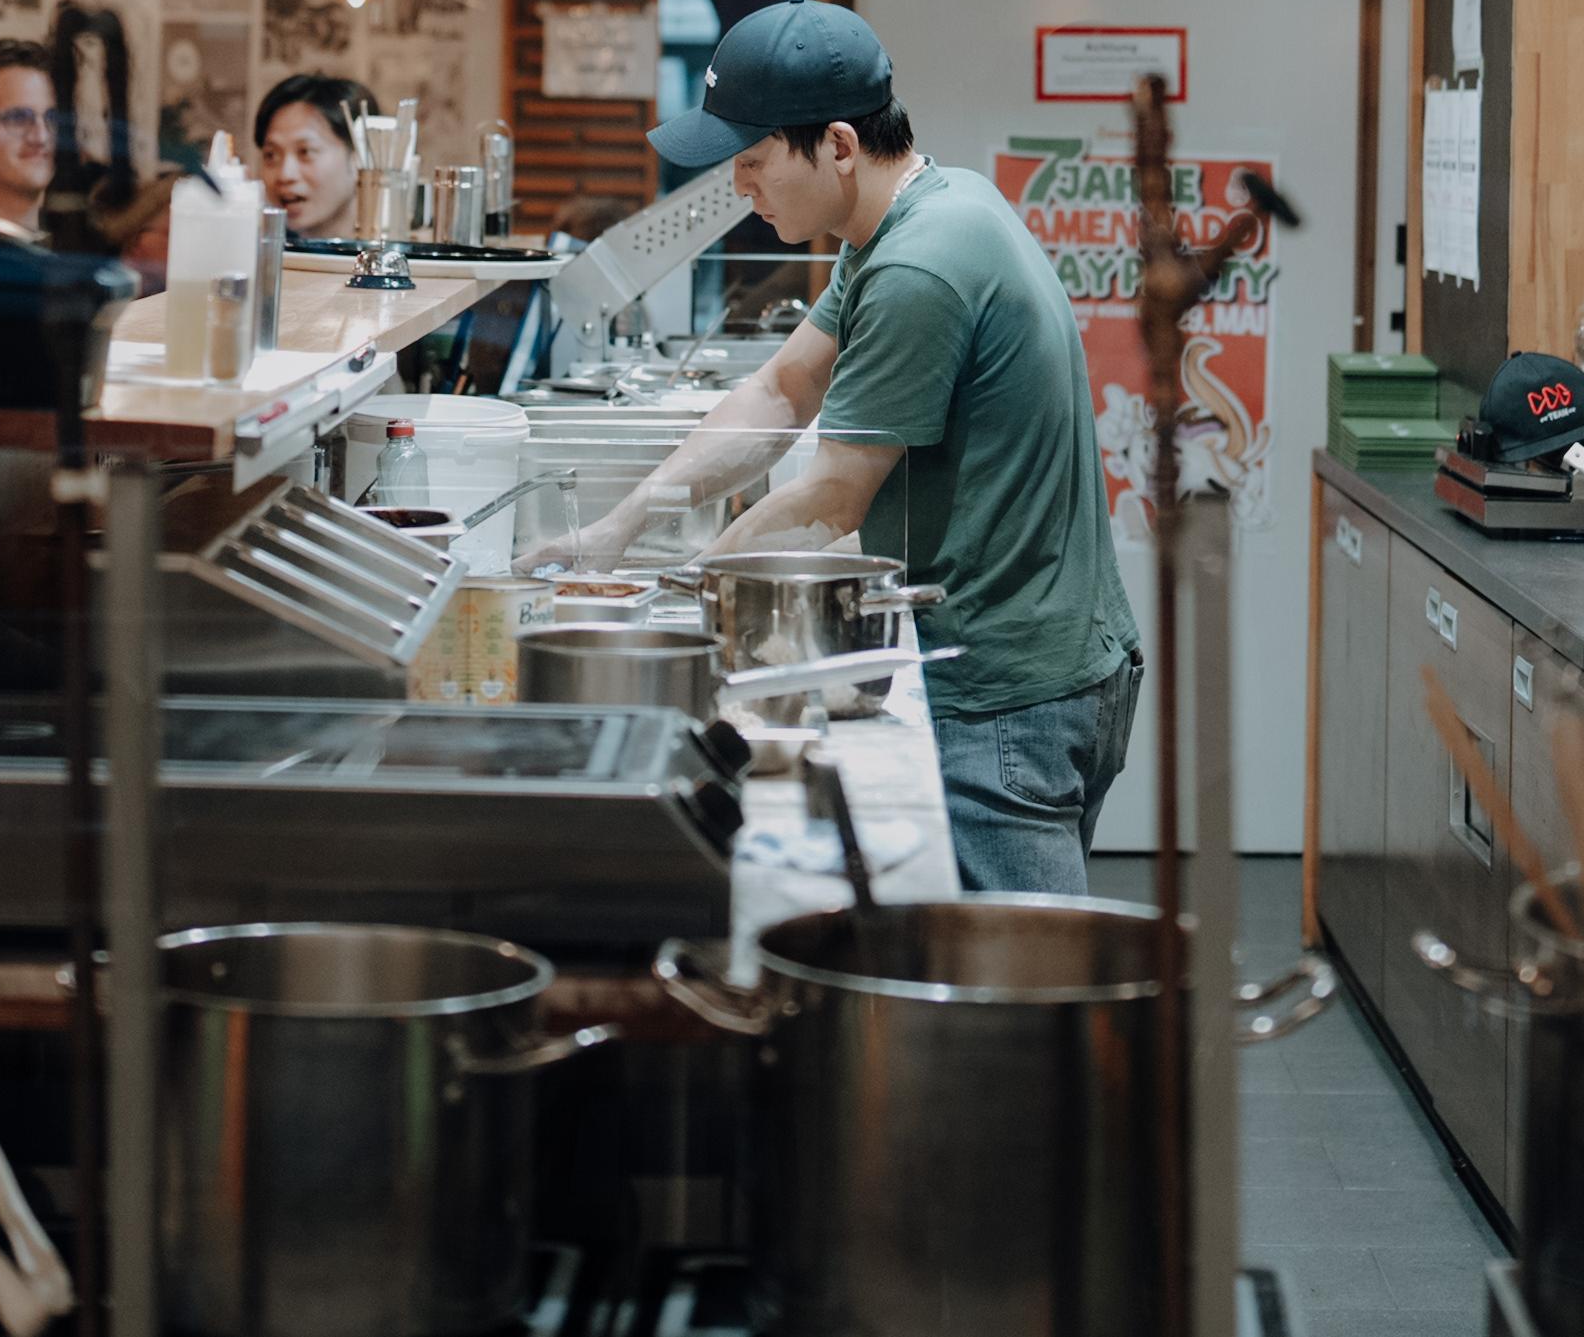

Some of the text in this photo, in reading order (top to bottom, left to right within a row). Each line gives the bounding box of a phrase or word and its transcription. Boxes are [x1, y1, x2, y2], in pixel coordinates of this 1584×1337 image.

[1008, 137, 1197, 203] 7 JAHE
[1022, 209, 1261, 253] AMENADO
[1215, 305, 1265, 335] MAI
